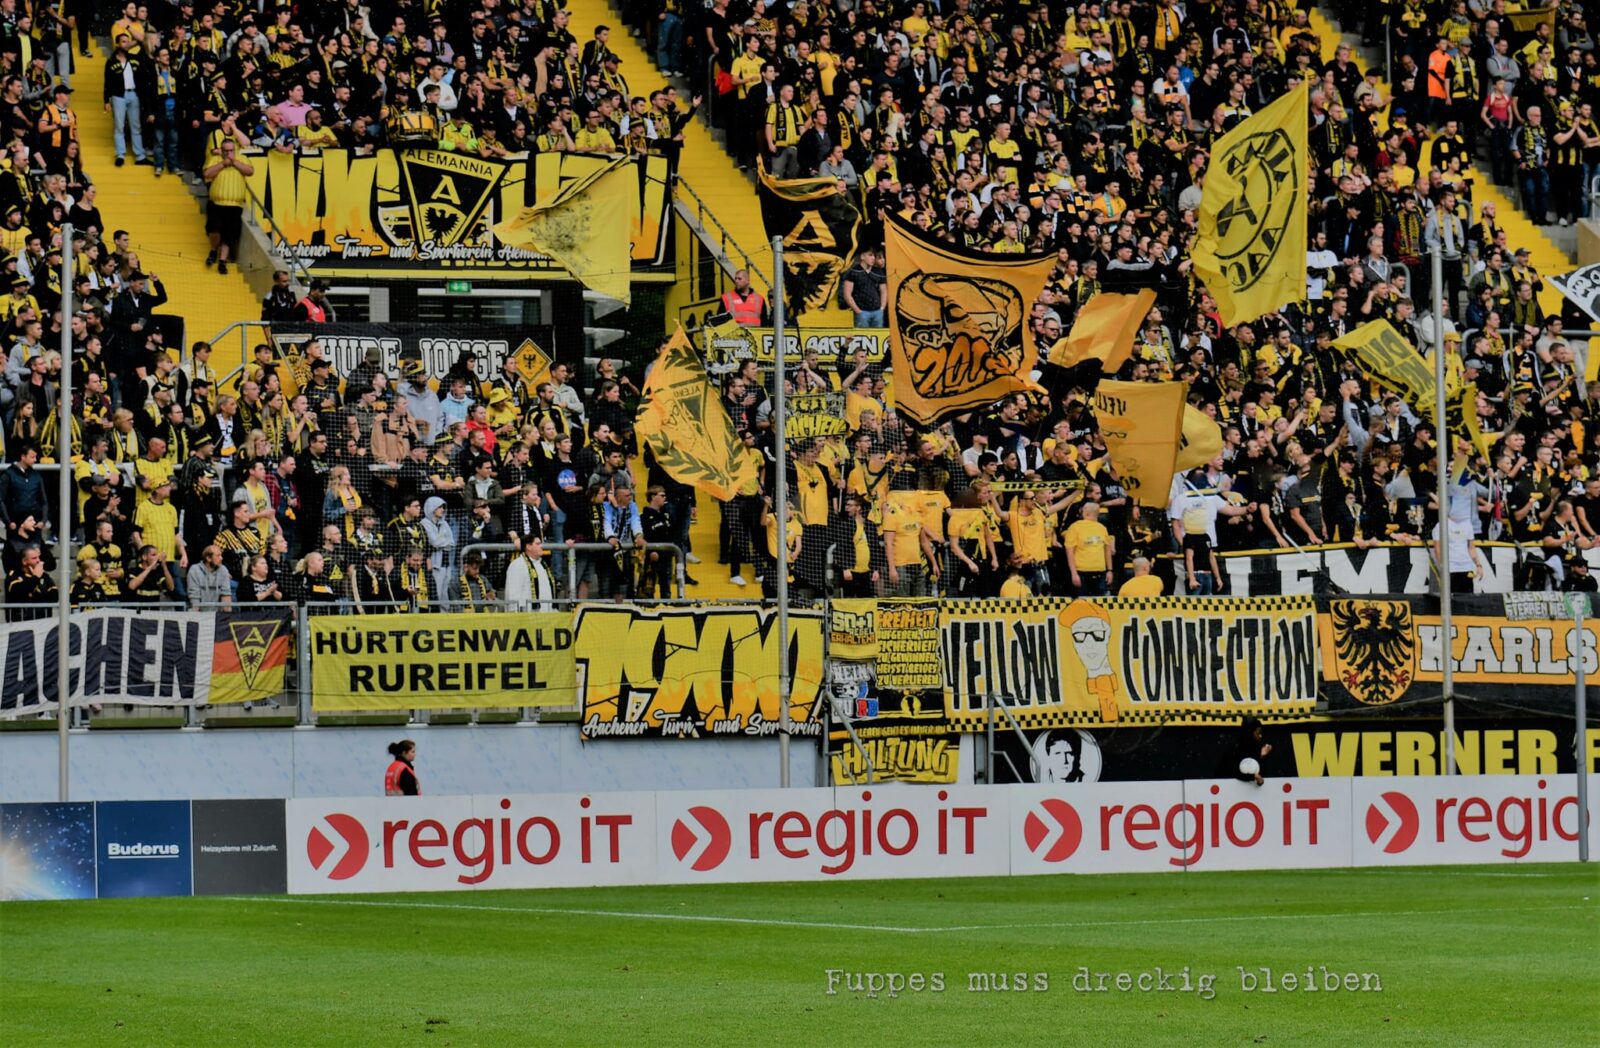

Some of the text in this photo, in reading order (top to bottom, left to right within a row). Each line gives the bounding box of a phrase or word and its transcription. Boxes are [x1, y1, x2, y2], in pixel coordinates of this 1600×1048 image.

[406, 148, 494, 177] ALEMANNIA
[389, 241, 413, 259] und
[763, 334, 801, 355] FR
[316, 625, 573, 655] HÜRTGENWALD
[1121, 614, 1316, 702] CONNECTION
[349, 661, 547, 693] RUREIFEL
[941, 617, 1061, 710] YELLOW
[713, 714, 741, 734] und
[842, 737, 949, 777] HALTUNG
[1291, 729, 1558, 778] WERNER
[749, 790, 918, 875] regio
[1100, 784, 1264, 866] regio
[1436, 779, 1590, 858] regio
[108, 842, 180, 857] Buderus
[385, 798, 560, 884] regio
